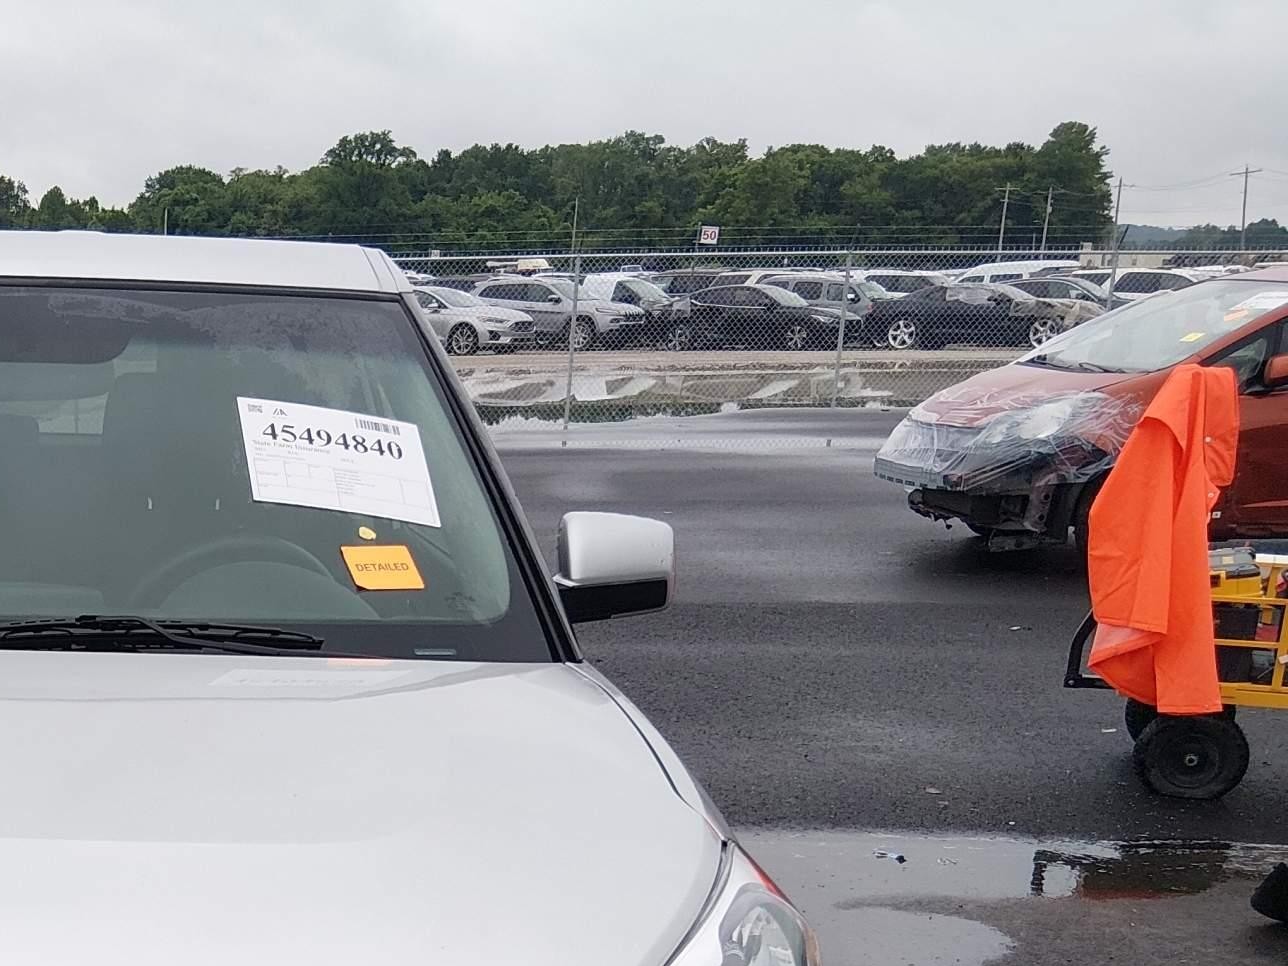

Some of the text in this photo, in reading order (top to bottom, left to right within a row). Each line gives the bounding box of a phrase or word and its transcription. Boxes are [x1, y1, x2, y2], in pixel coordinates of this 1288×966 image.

[702, 230, 717, 241] 50
[262, 422, 403, 460] 45494840
[355, 562, 409, 572] DETAILED
